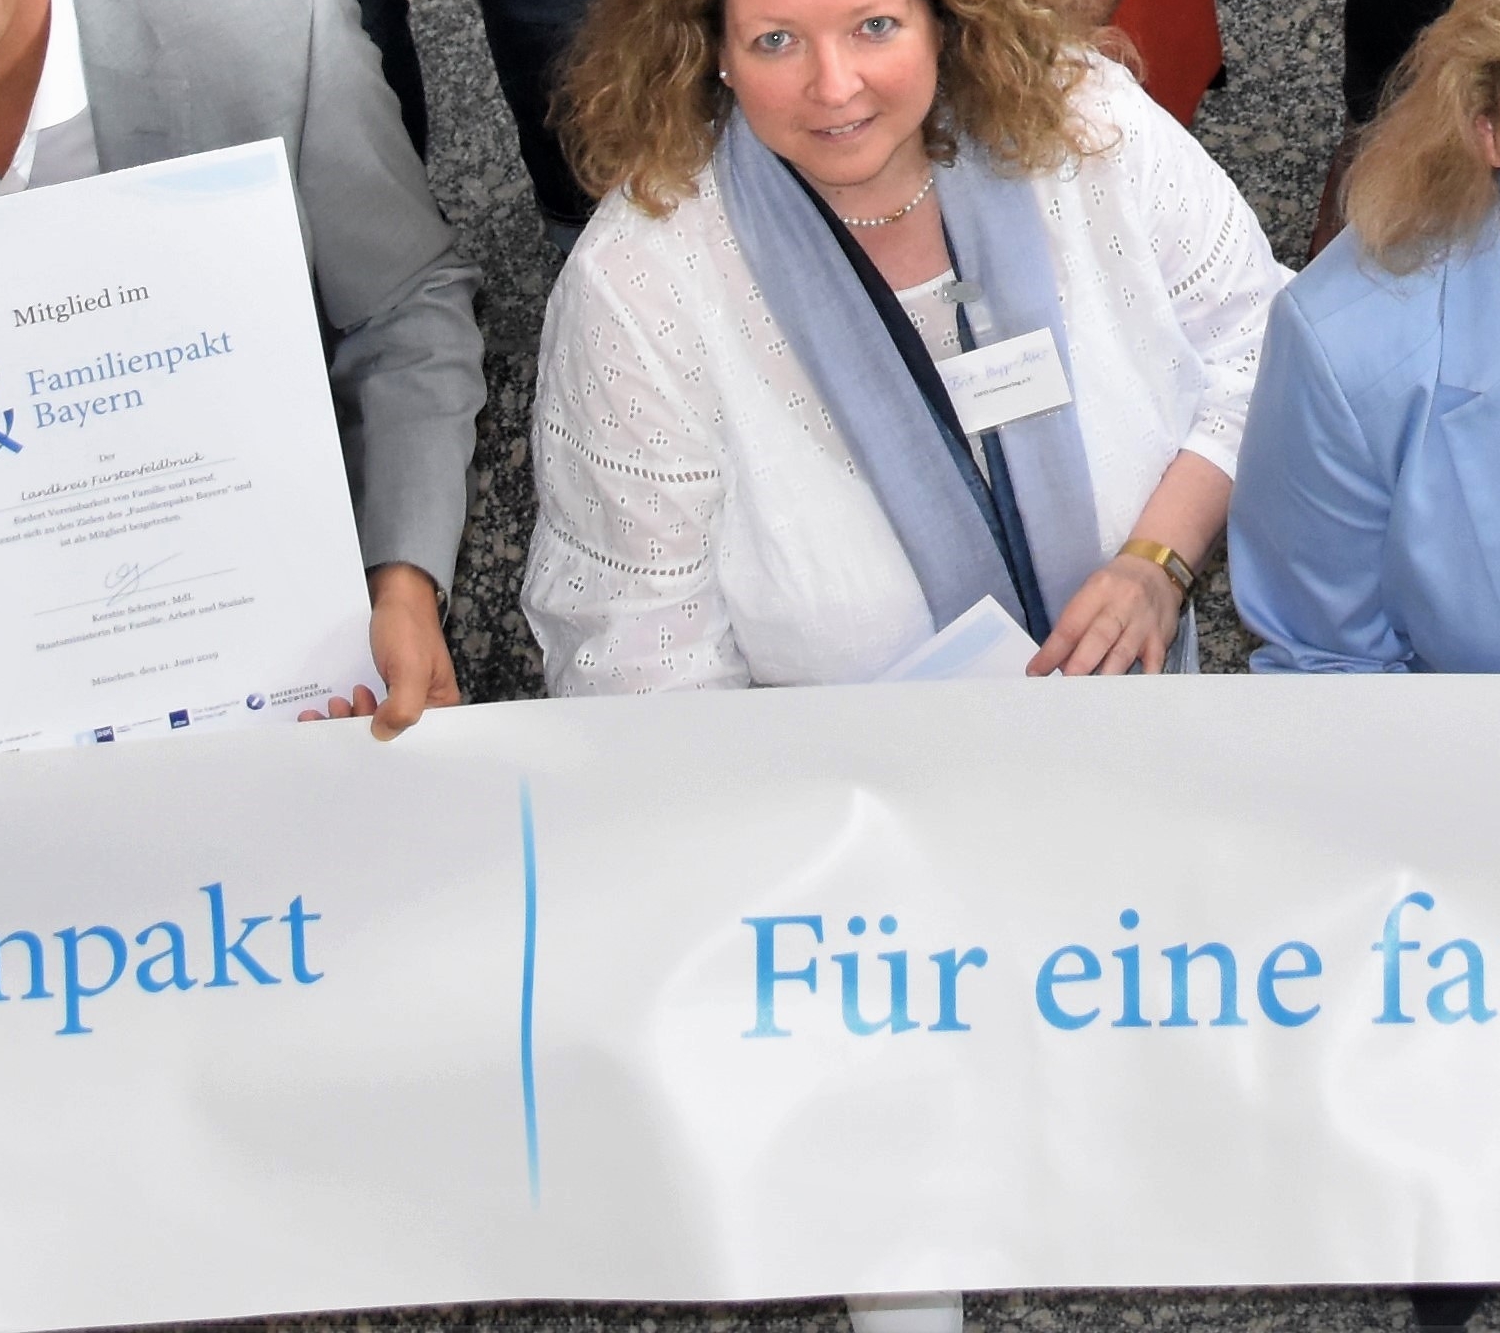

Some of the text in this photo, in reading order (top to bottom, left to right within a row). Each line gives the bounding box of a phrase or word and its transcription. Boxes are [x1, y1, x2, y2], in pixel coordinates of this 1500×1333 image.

[12, 283, 151, 329] Mitglied im
[27, 330, 234, 397] Familienpakt
[33, 386, 145, 431] Bayern
[740, 910, 988, 1040] Für
[1035, 907, 1323, 1031] eine
